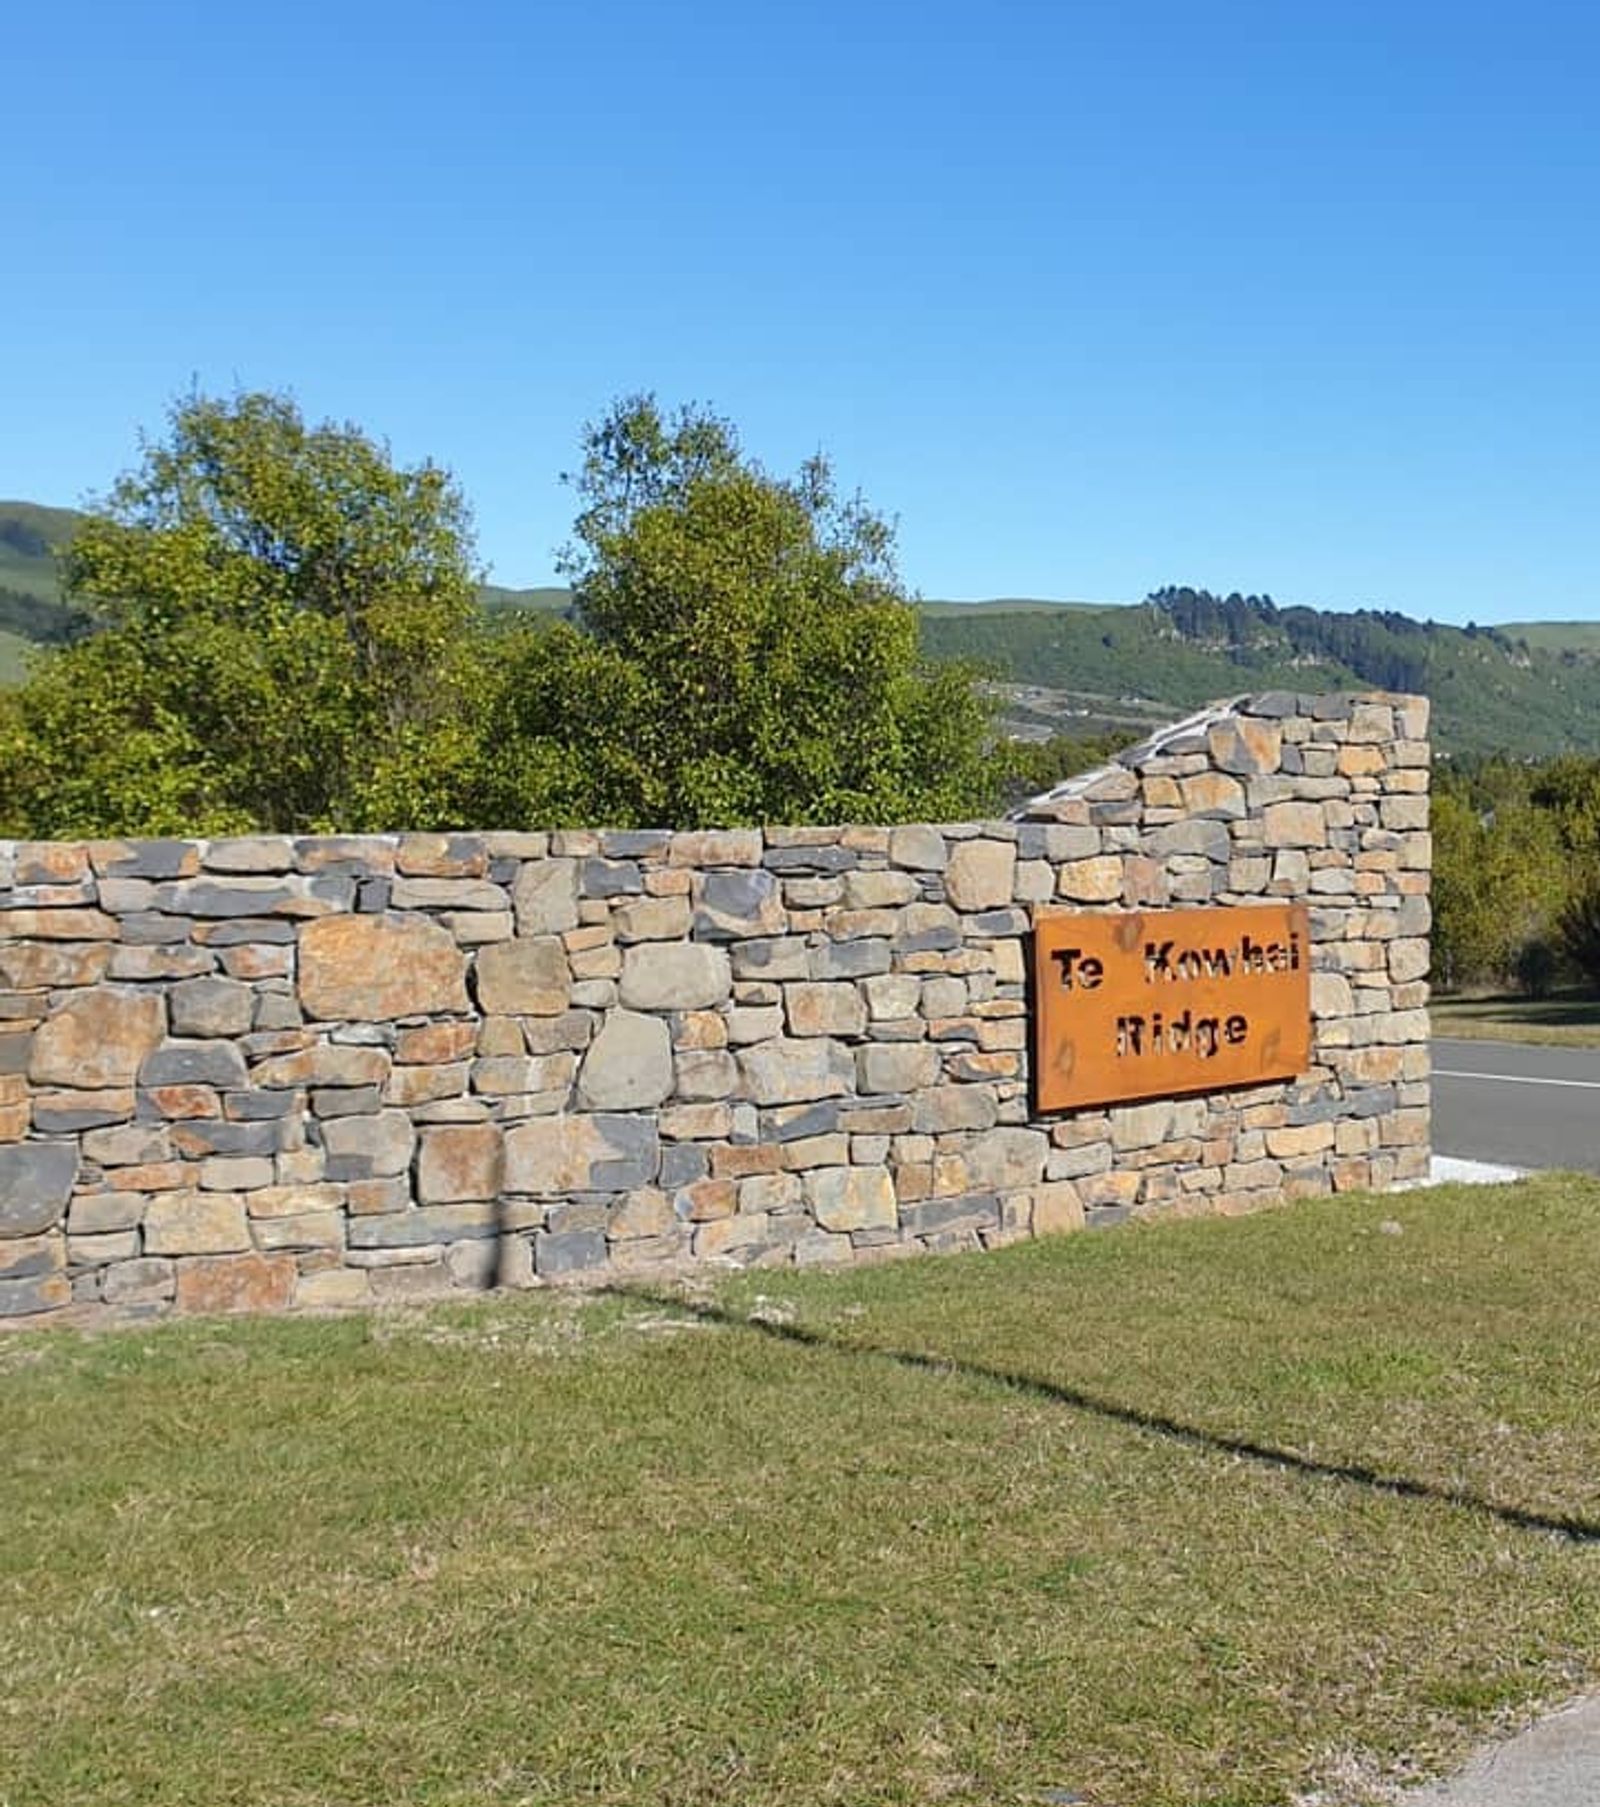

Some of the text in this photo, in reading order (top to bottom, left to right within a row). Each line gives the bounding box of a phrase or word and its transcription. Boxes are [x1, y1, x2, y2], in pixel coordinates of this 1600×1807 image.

[1050, 932, 1300, 991] Te Kowhai
[1116, 1009, 1249, 1058] Ridge
